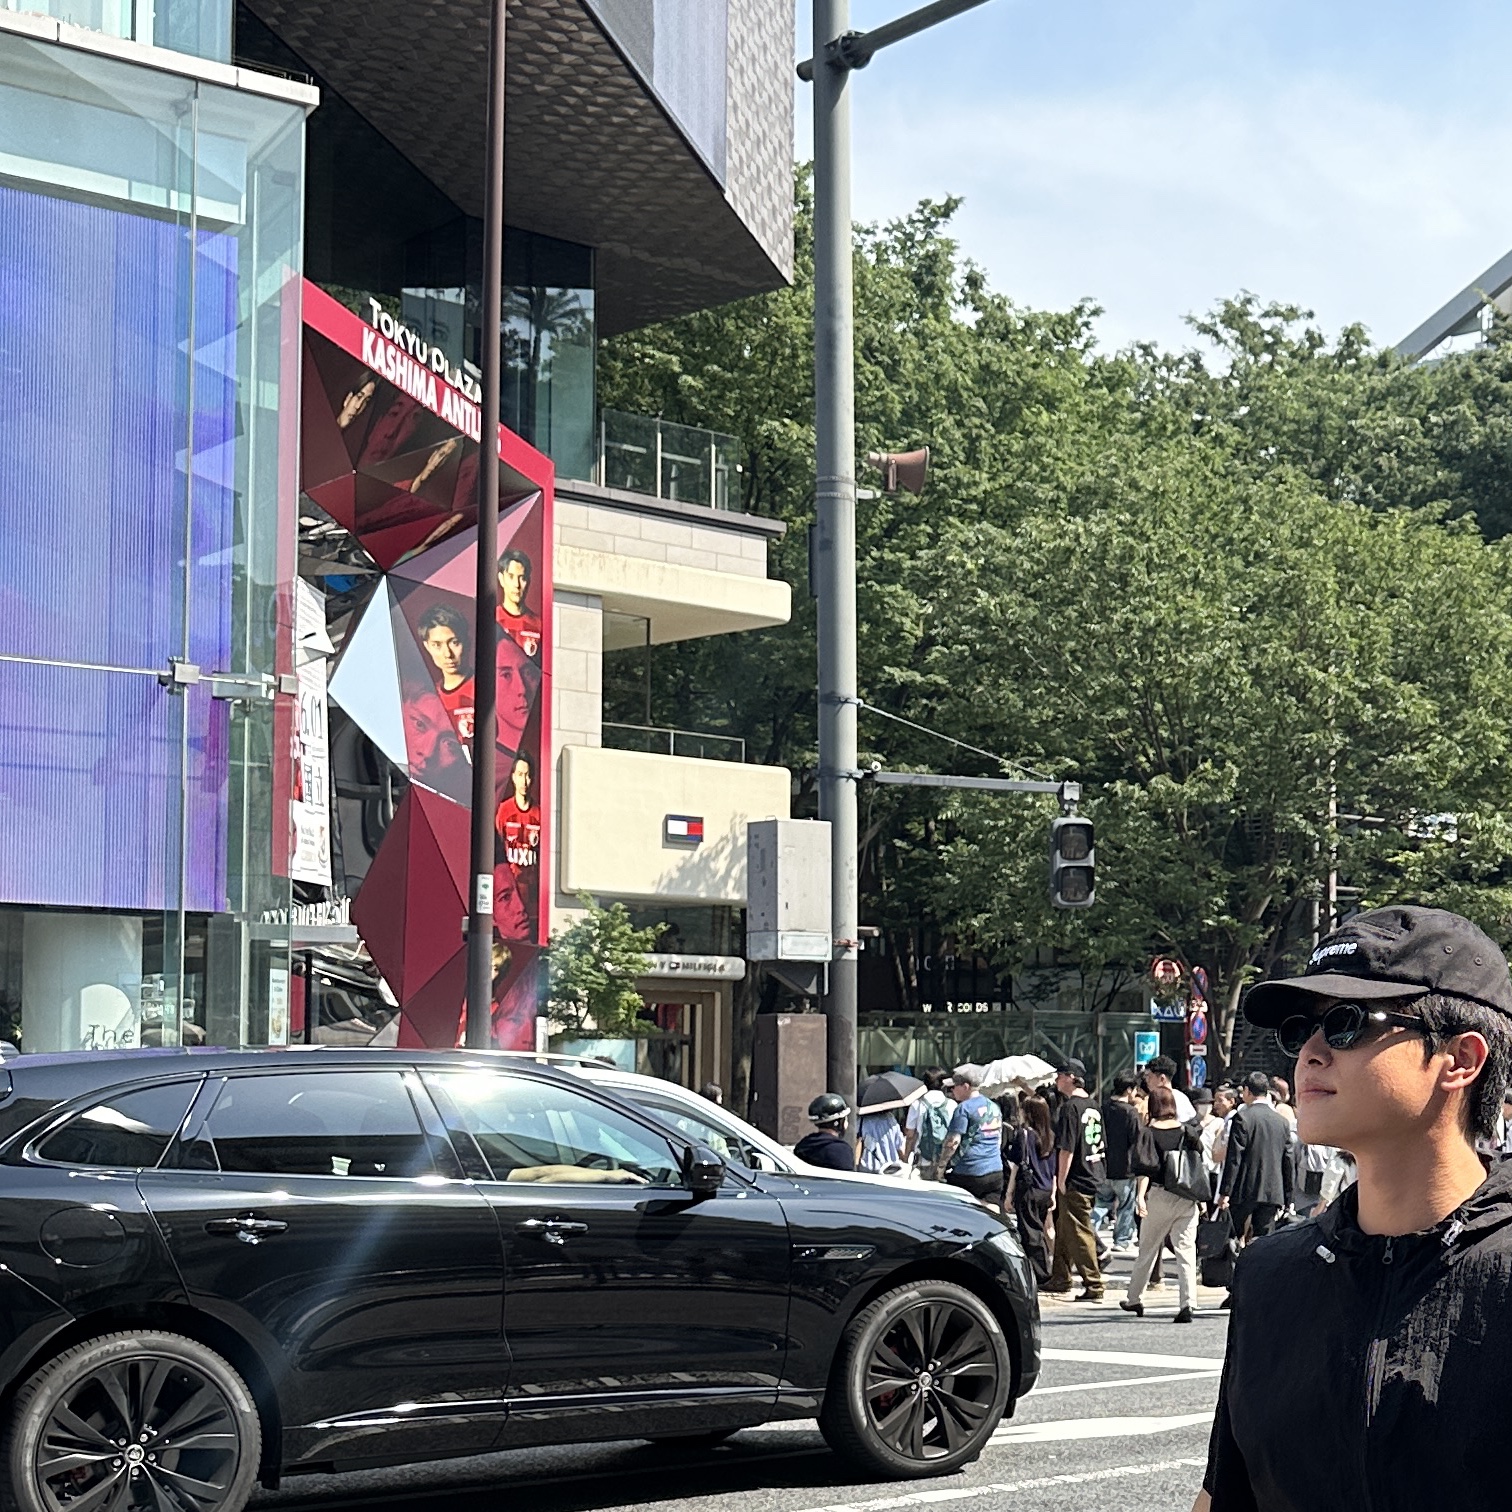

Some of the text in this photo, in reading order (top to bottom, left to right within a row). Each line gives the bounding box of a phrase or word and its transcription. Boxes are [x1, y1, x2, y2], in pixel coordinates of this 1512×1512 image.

[361, 326, 438, 418] KASHIMA
[369, 297, 482, 404] TOKYU PLAZA
